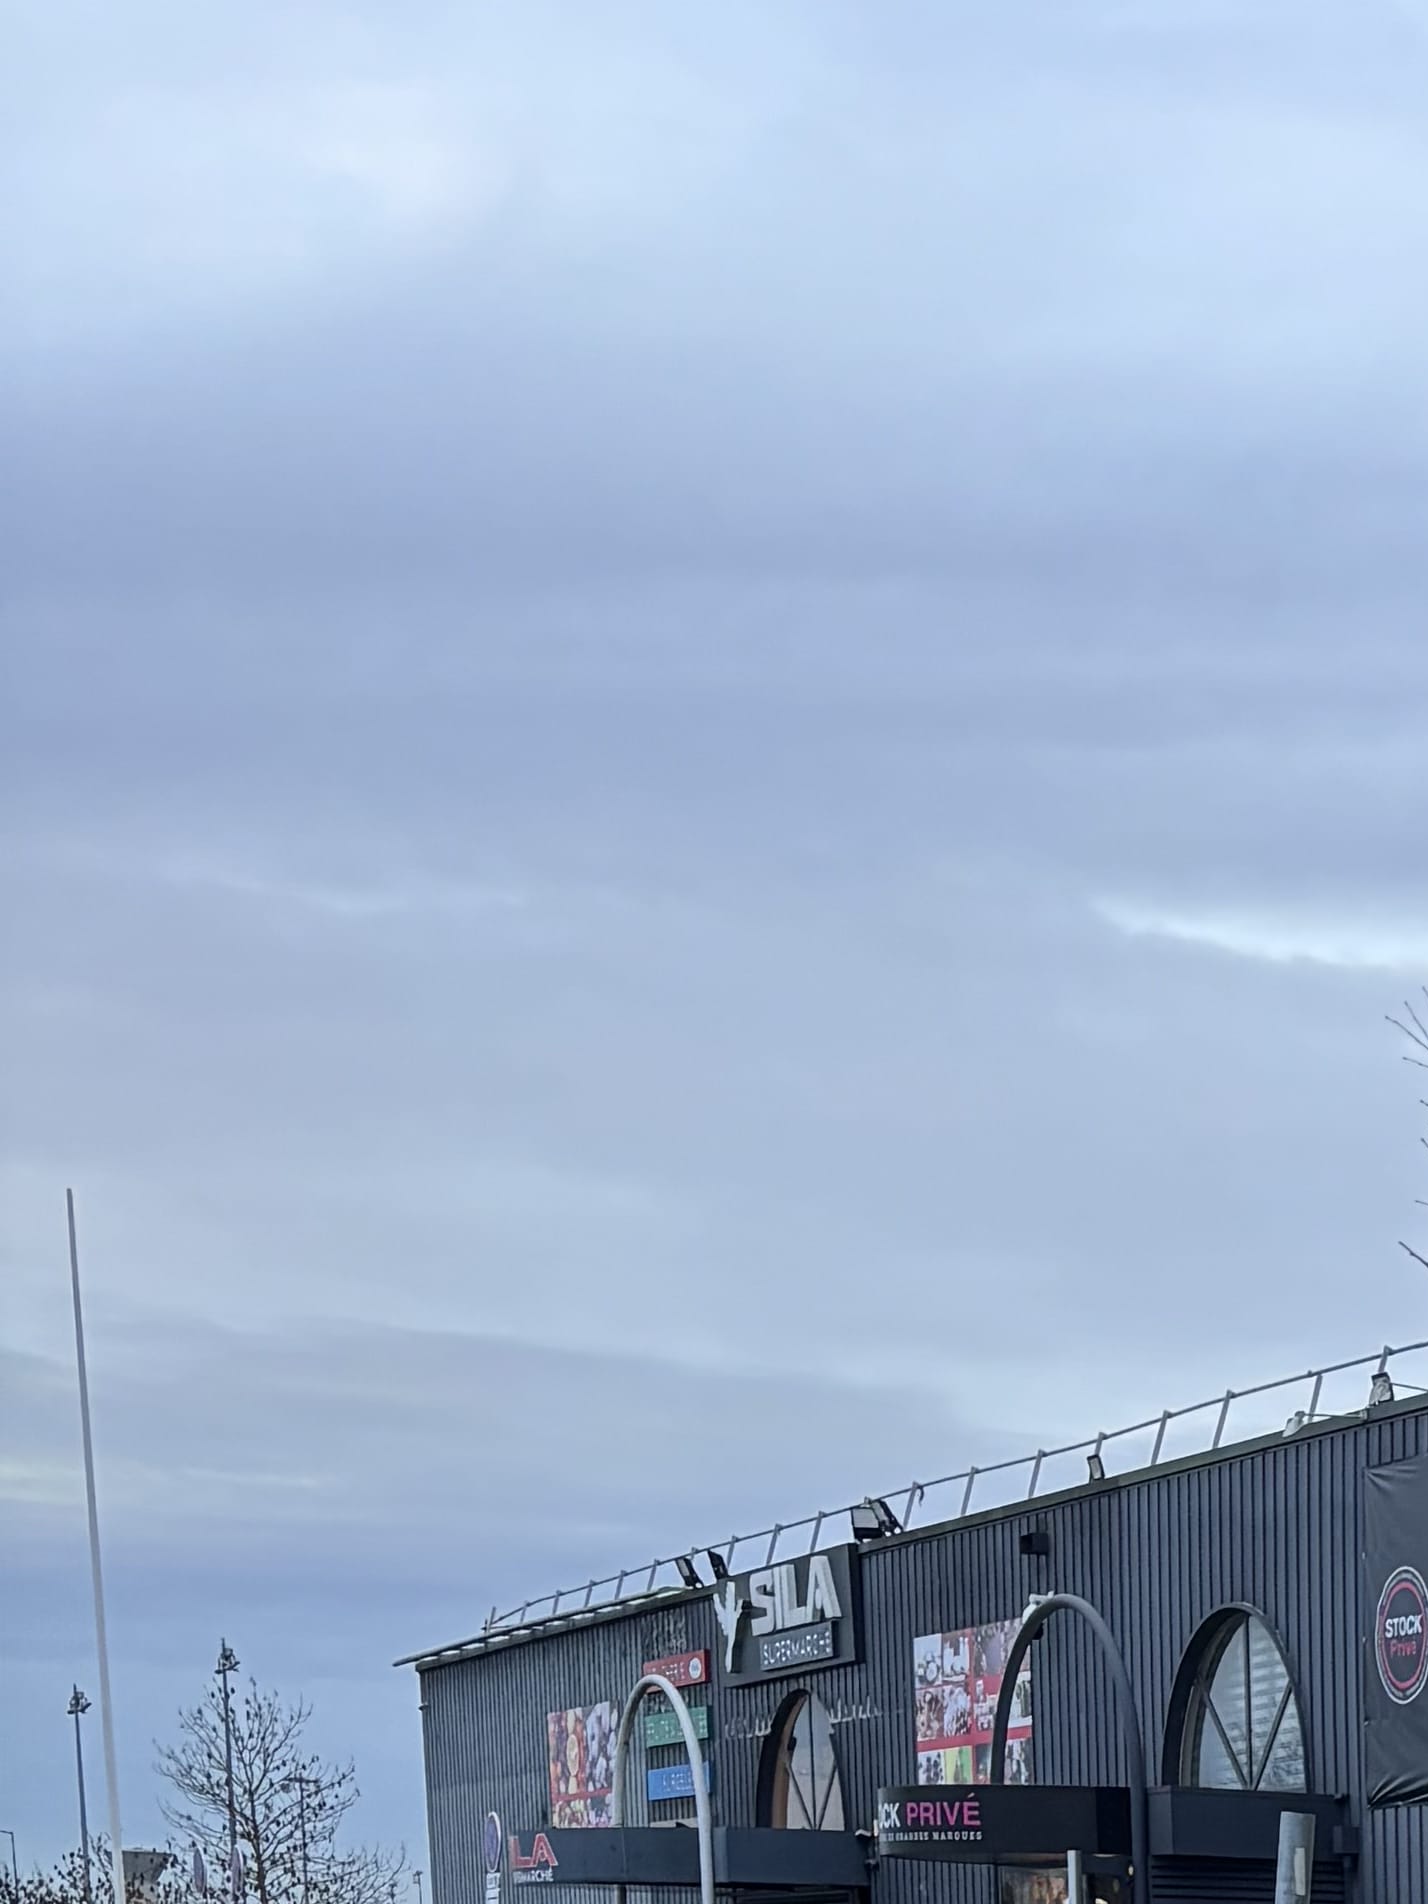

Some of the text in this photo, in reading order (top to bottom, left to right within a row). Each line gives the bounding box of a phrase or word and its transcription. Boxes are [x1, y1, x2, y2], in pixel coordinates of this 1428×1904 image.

[1385, 1615, 1423, 1638] STOCK
[906, 1792, 981, 1827] PRIVÉ
[932, 1831, 983, 1841] MARQUES
